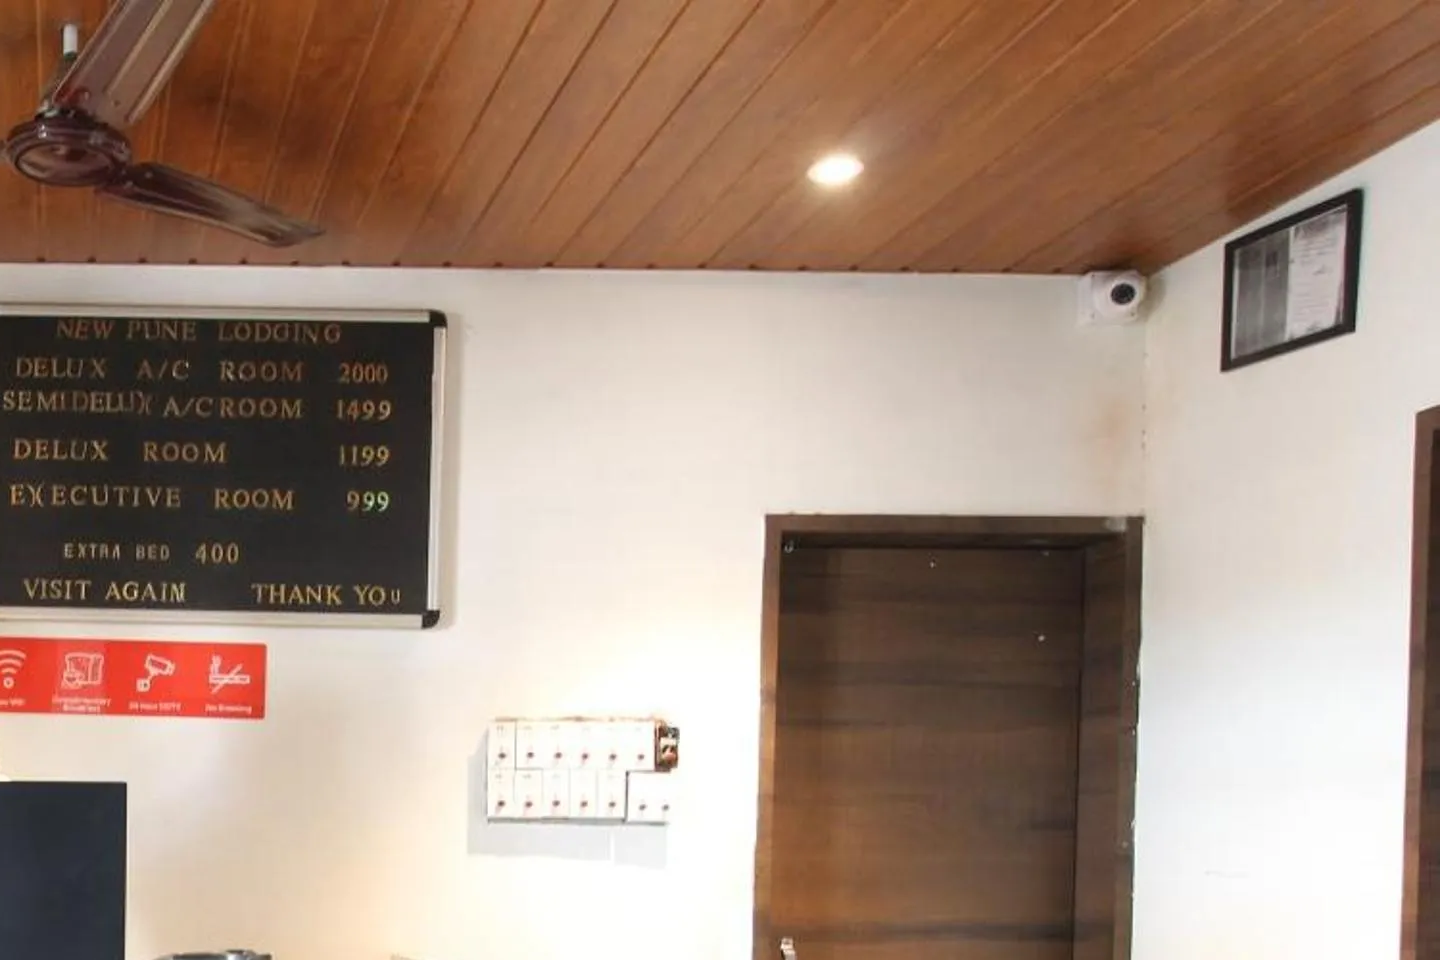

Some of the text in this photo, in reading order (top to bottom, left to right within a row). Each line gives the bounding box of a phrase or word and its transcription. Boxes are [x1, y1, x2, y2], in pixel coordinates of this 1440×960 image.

[56, 320, 342, 344] NEW PUNE LODGING
[16, 357, 389, 384] DELUX A/C ROOM 2000
[335, 399, 392, 422] 1499
[13, 440, 391, 468] DELUX ROOM 1199
[10, 484, 391, 513] EXECUTIVE ROOM 999
[64, 542, 240, 565] EXTRA BED 400
[23, 578, 93, 601] VISIT
[105, 580, 187, 604] AGAIN
[250, 583, 343, 606] THANK
